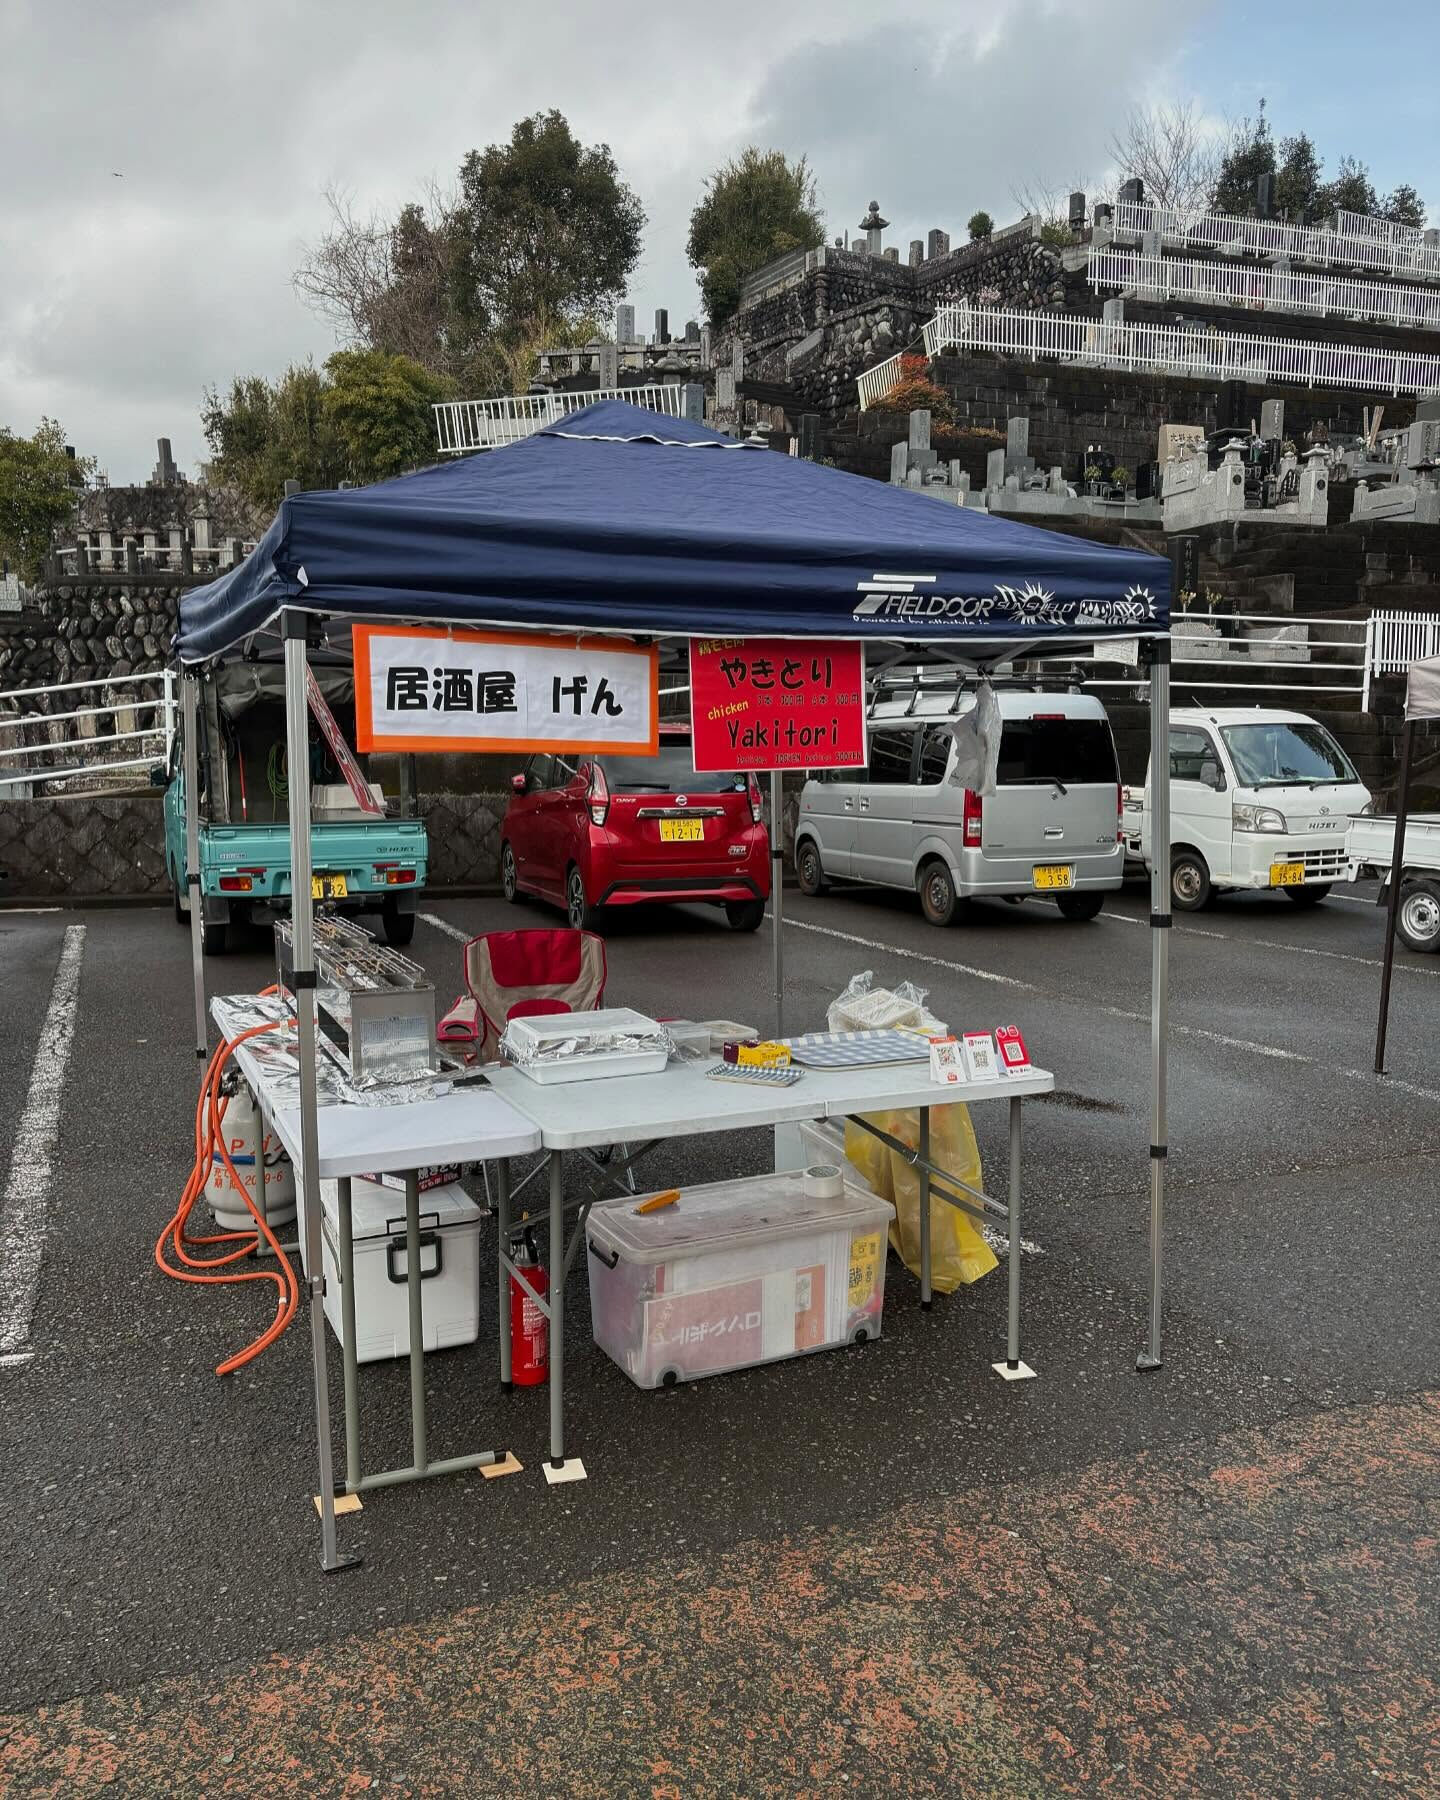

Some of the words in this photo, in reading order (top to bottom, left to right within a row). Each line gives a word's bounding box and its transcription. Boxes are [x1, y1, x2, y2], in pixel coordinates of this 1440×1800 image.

[885, 595, 994, 617] FIELDOOR
[996, 600, 1073, 613] SUNSHIELD
[720, 657, 833, 690] やきとり
[386, 666, 518, 714] 居酒屋
[552, 675, 624, 717] げん
[707, 700, 750, 721] chicken
[727, 718, 838, 749] Yakitori
[671, 827, 701, 840] 12-17
